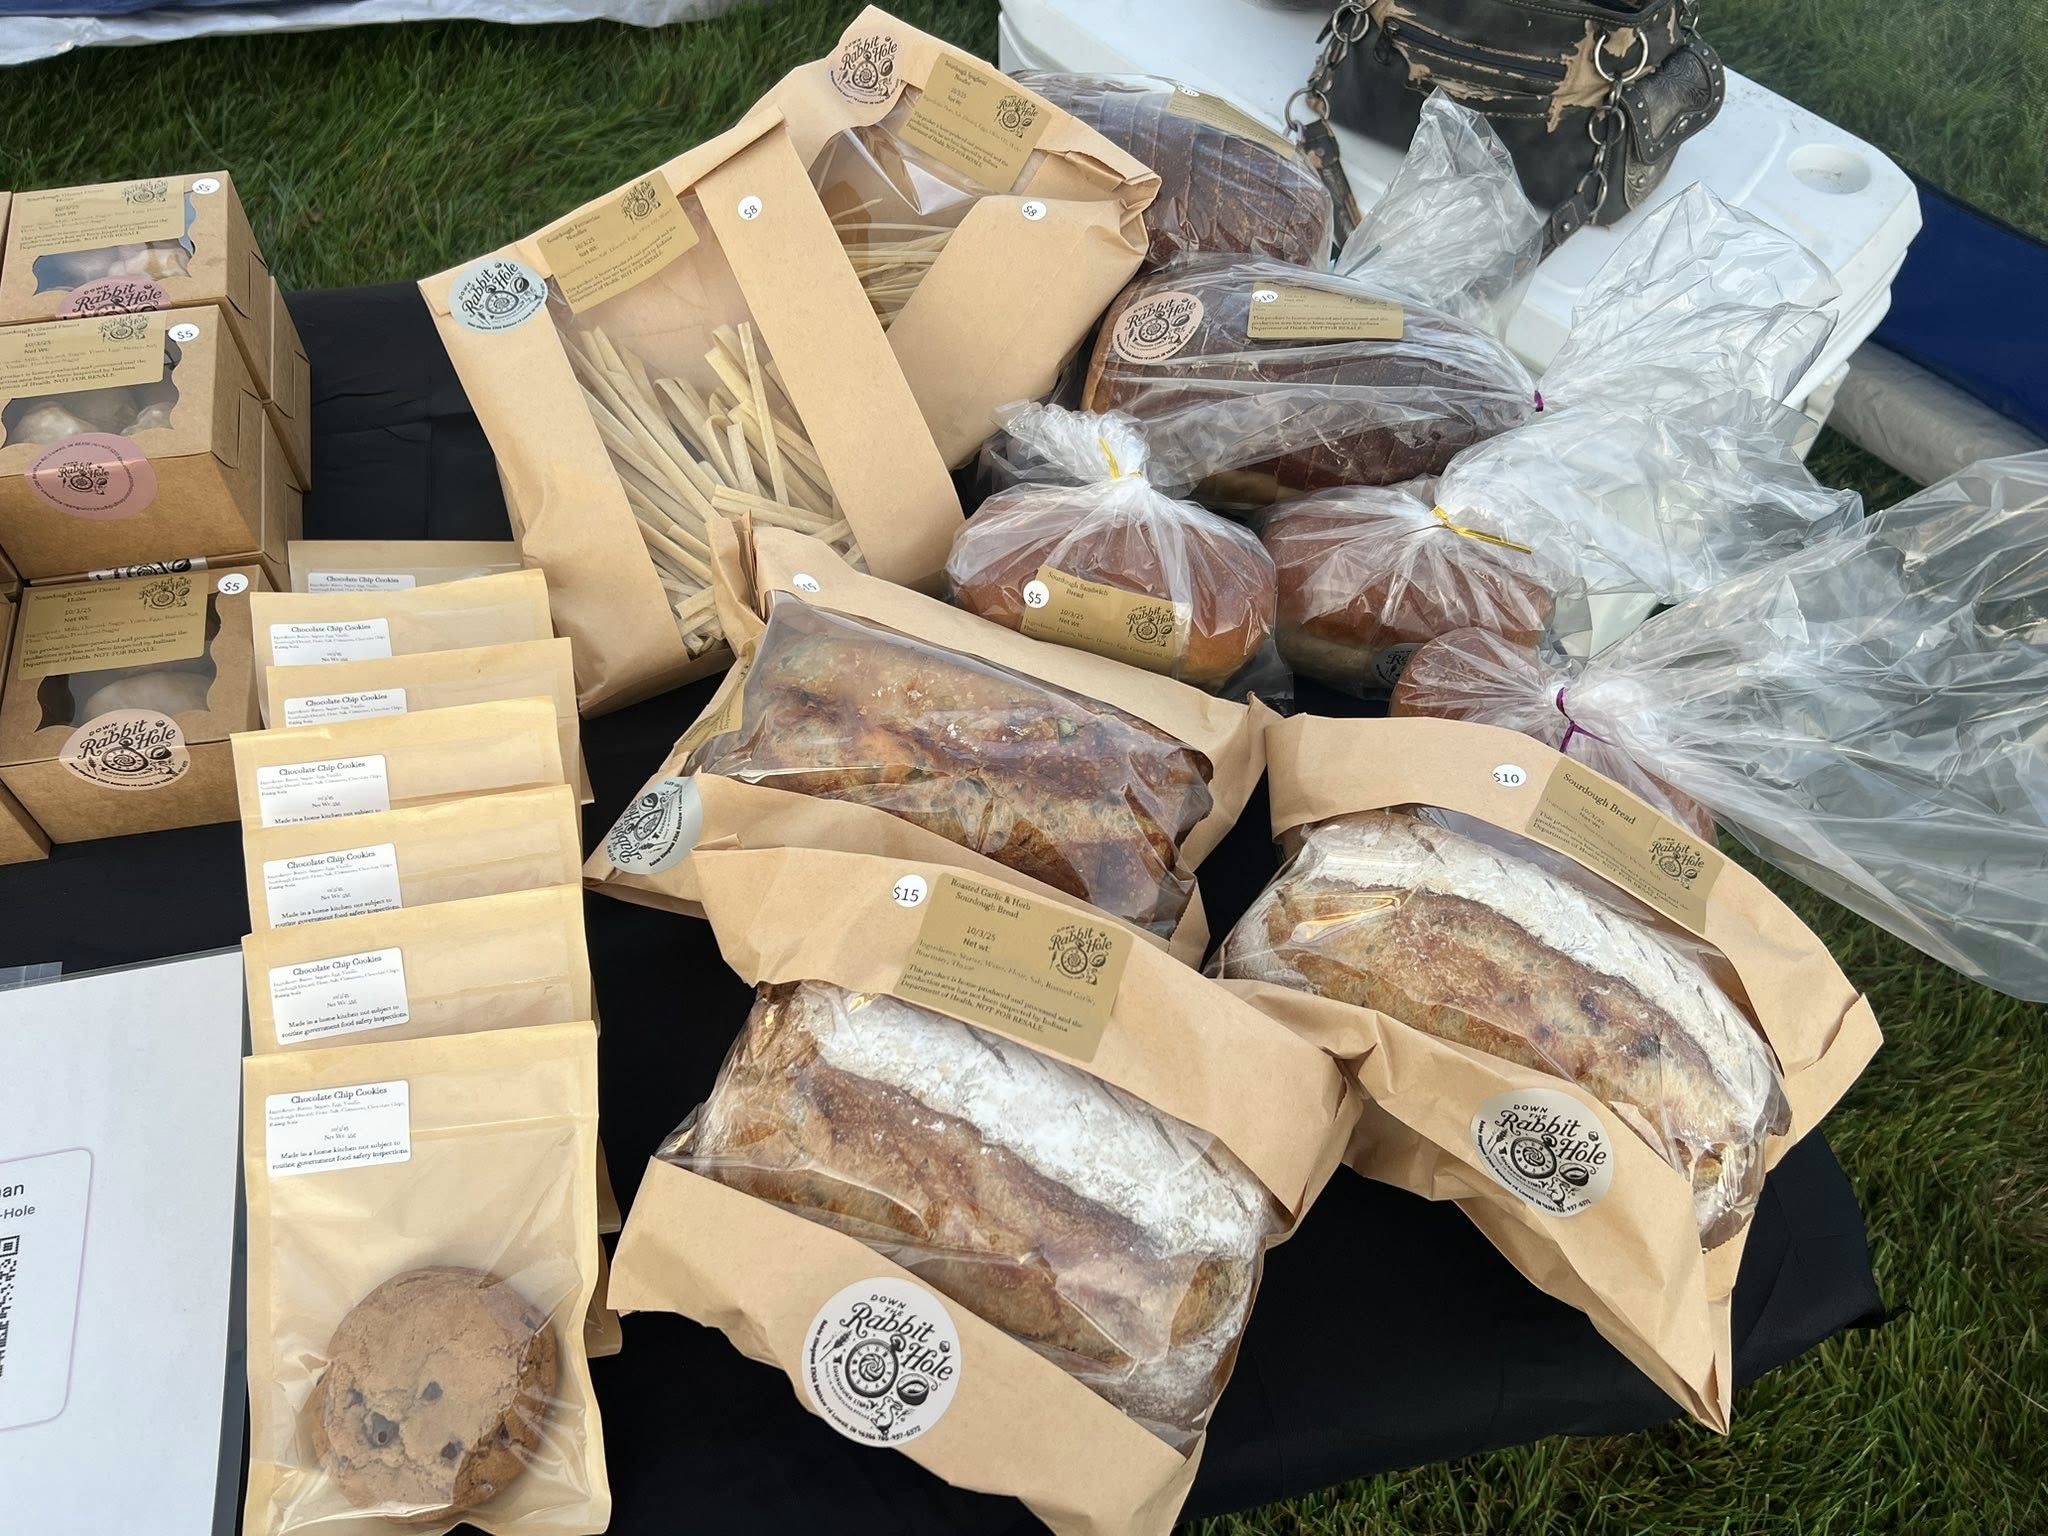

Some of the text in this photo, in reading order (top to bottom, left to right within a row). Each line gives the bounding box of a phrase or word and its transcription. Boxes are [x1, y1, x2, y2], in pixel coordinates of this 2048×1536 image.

[839, 36, 879, 70] Rabbit
[873, 41, 897, 62] Hole
[744, 205, 757, 218] $8
[1024, 206, 1037, 216] $8
[492, 263, 518, 290] Hole
[73, 284, 136, 312] Rabbit
[126, 288, 161, 306] Hole
[462, 269, 493, 317] Rabbit
[1125, 299, 1173, 330] Rabbit
[1165, 299, 1196, 319] Hole
[177, 330, 193, 340] $5
[58, 462, 92, 478] Rabbit
[87, 468, 109, 477] Hole
[140, 577, 173, 599] Rabbit
[171, 578, 192, 591] Hole
[224, 582, 240, 592] $5
[1028, 591, 1042, 604] $5
[1127, 607, 1161, 625] Rabbit
[305, 693, 387, 706] Chocolate Chip Cookies
[89, 722, 118, 736] DOWN
[136, 725, 175, 749] Hole
[77, 720, 147, 759] Rabbit
[279, 760, 365, 776] Chocolate Chip Cookies
[1493, 772, 1519, 784] $10
[1561, 772, 1636, 825] Sourdough Bread
[1649, 840, 1691, 854] Rabbit
[286, 850, 375, 869] Chocolate Chip Cookies
[1681, 854, 1705, 869] Hole
[893, 886, 919, 902] $15
[950, 878, 1031, 910] Roasted Garlic & Herb
[954, 891, 1019, 919] Sourdough Bread
[966, 925, 996, 942] 10/3/25
[1048, 928, 1094, 951] Rabbit
[962, 938, 978, 949] Net
[1085, 939, 1112, 954] Hole
[292, 954, 381, 976] Chocolate Chip Cookies
[318, 1014, 335, 1022] home
[336, 1010, 358, 1019] kitchen
[371, 1005, 391, 1015] subject
[282, 1030, 302, 1038] routine
[303, 1023, 339, 1035] government
[355, 1017, 372, 1026] safety
[373, 1011, 407, 1023] inspections.
[290, 1085, 387, 1104] Chocolate Chip Cookies
[1513, 1104, 1548, 1113] DOWN
[1495, 1110, 1581, 1138] Rabbit
[272, 1161, 294, 1169] routine
[296, 1156, 335, 1167] government
[352, 1151, 371, 1160] safety
[372, 1147, 408, 1157] inspections.
[280, 1151, 298, 1159] Made
[313, 1147, 331, 1155] home
[333, 1144, 356, 1152] kitchen
[370, 1140, 392, 1150] subject
[1557, 1138, 1607, 1165] Hole
[871, 1294, 906, 1308] DOWN
[884, 1307, 904, 1317] THE
[840, 1302, 935, 1343] Rabbit
[900, 1342, 953, 1381] Hole
